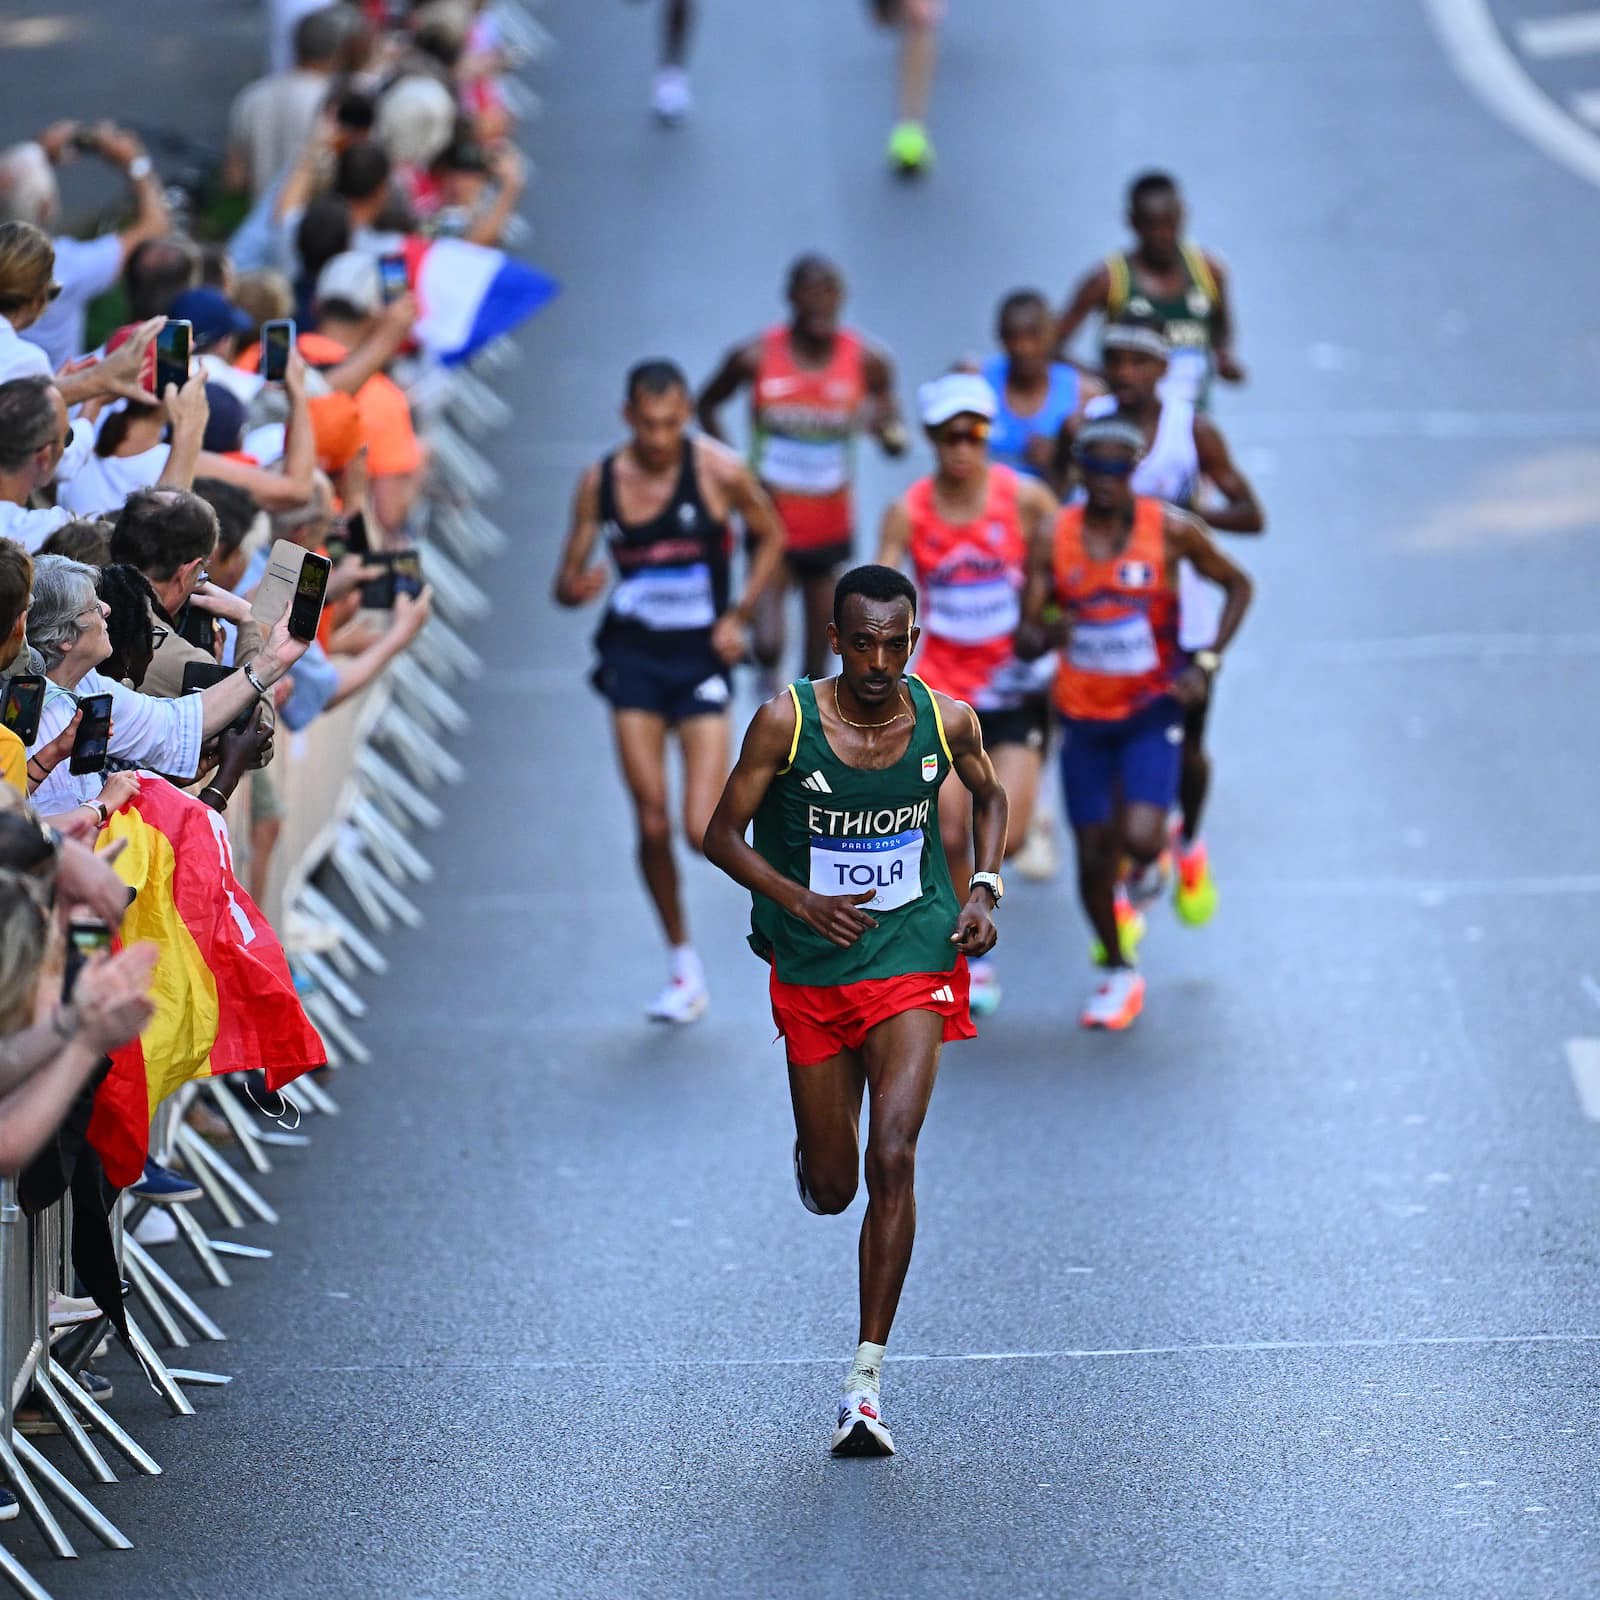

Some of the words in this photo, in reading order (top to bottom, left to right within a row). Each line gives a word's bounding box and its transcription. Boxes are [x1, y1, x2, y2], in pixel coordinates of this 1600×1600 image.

[808, 799, 930, 836] ETHIOPIA
[875, 839, 901, 849] 2024
[833, 859, 903, 887] TOLA
